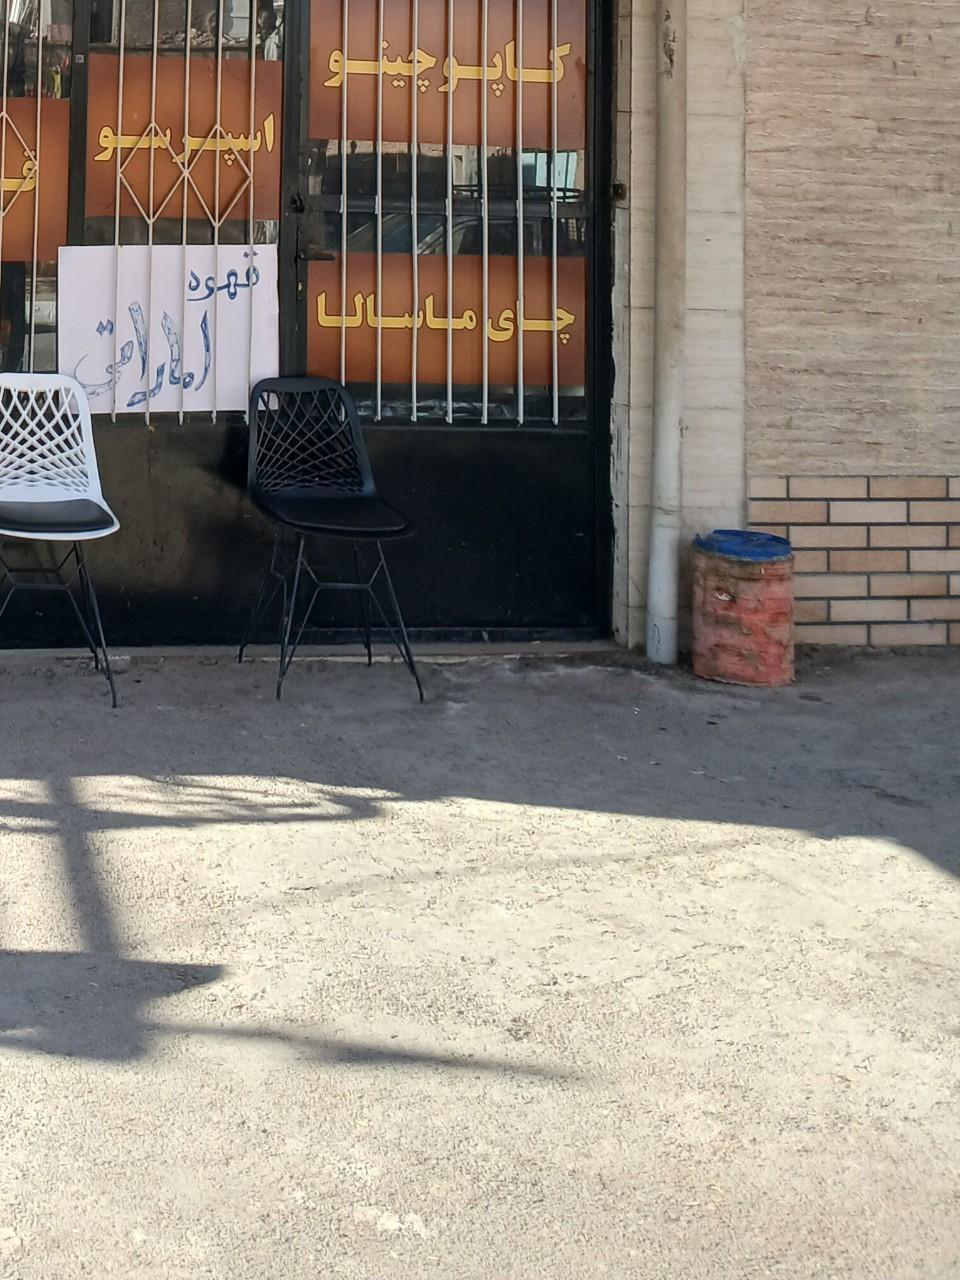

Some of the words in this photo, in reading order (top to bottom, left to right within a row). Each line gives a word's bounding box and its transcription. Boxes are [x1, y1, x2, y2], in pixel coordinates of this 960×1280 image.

[323, 39, 572, 97] کاپوچینو
[93, 112, 276, 167] اسپرسو
[316, 291, 477, 329] ماسالا
[486, 293, 576, 344] چای
